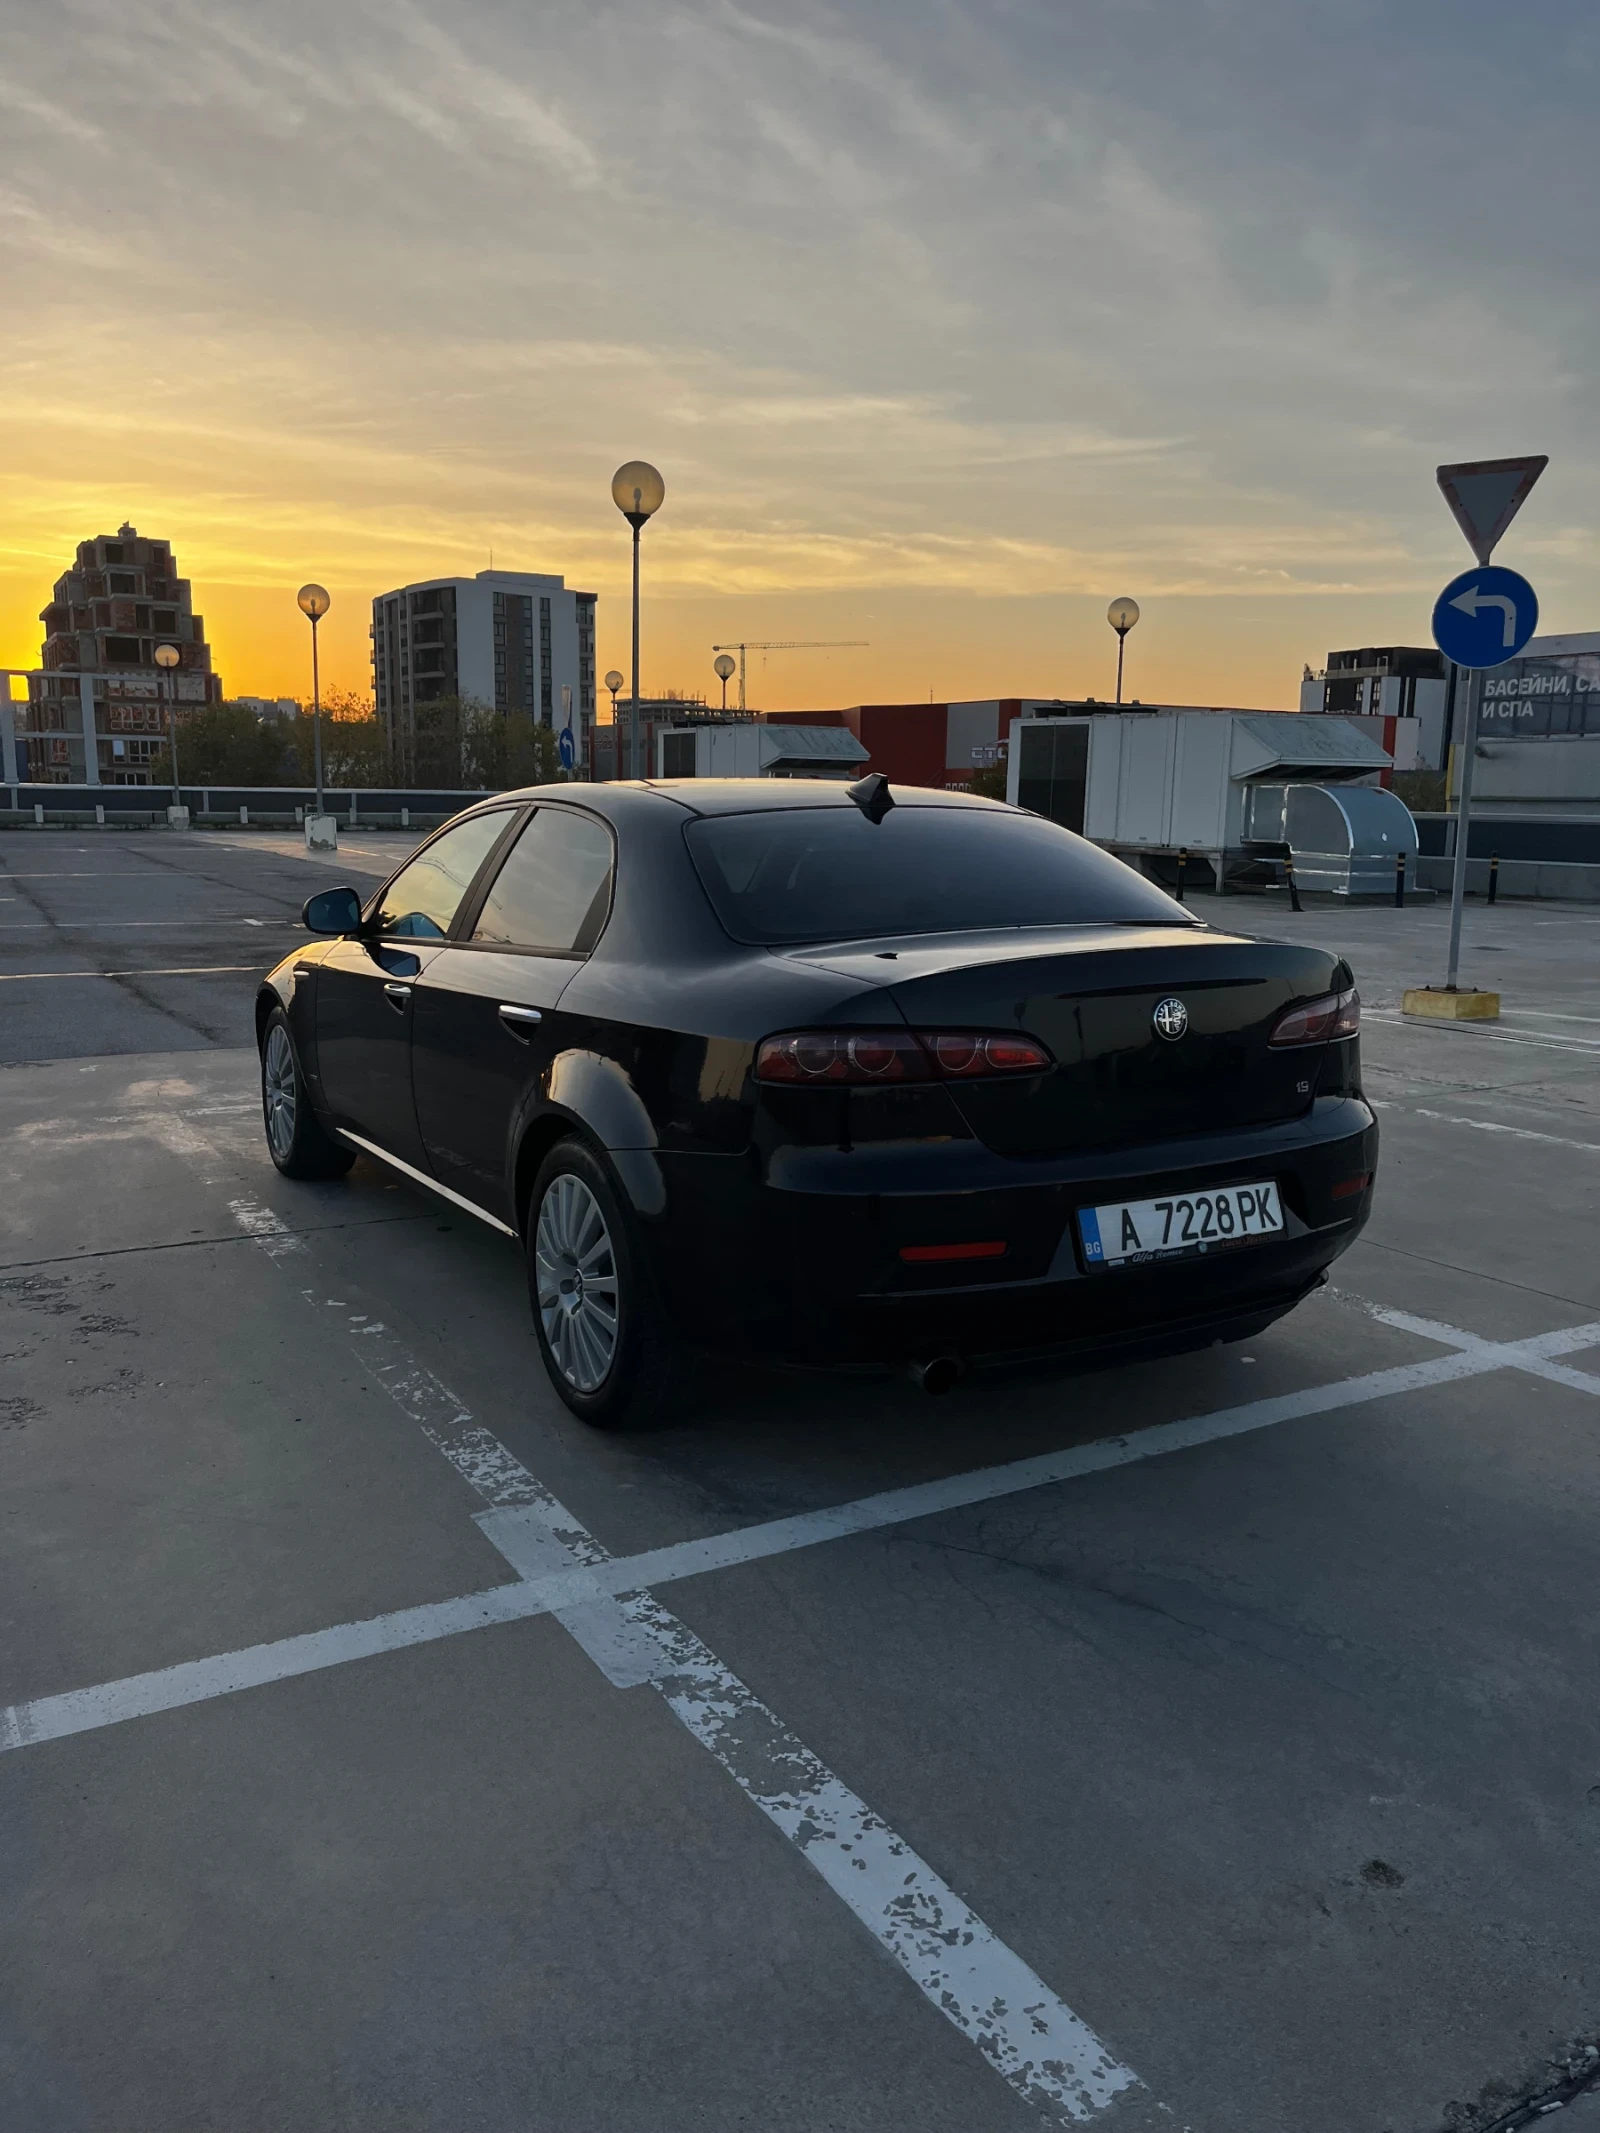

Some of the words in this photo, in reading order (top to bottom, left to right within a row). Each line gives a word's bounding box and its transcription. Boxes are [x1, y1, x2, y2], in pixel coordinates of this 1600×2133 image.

[1484, 673, 1570, 697] БАСЕЙНИ,
[1482, 702, 1495, 718] И
[1498, 701, 1534, 718] СПА
[1121, 1209, 1142, 1251] A
[1085, 1241, 1100, 1256] BG
